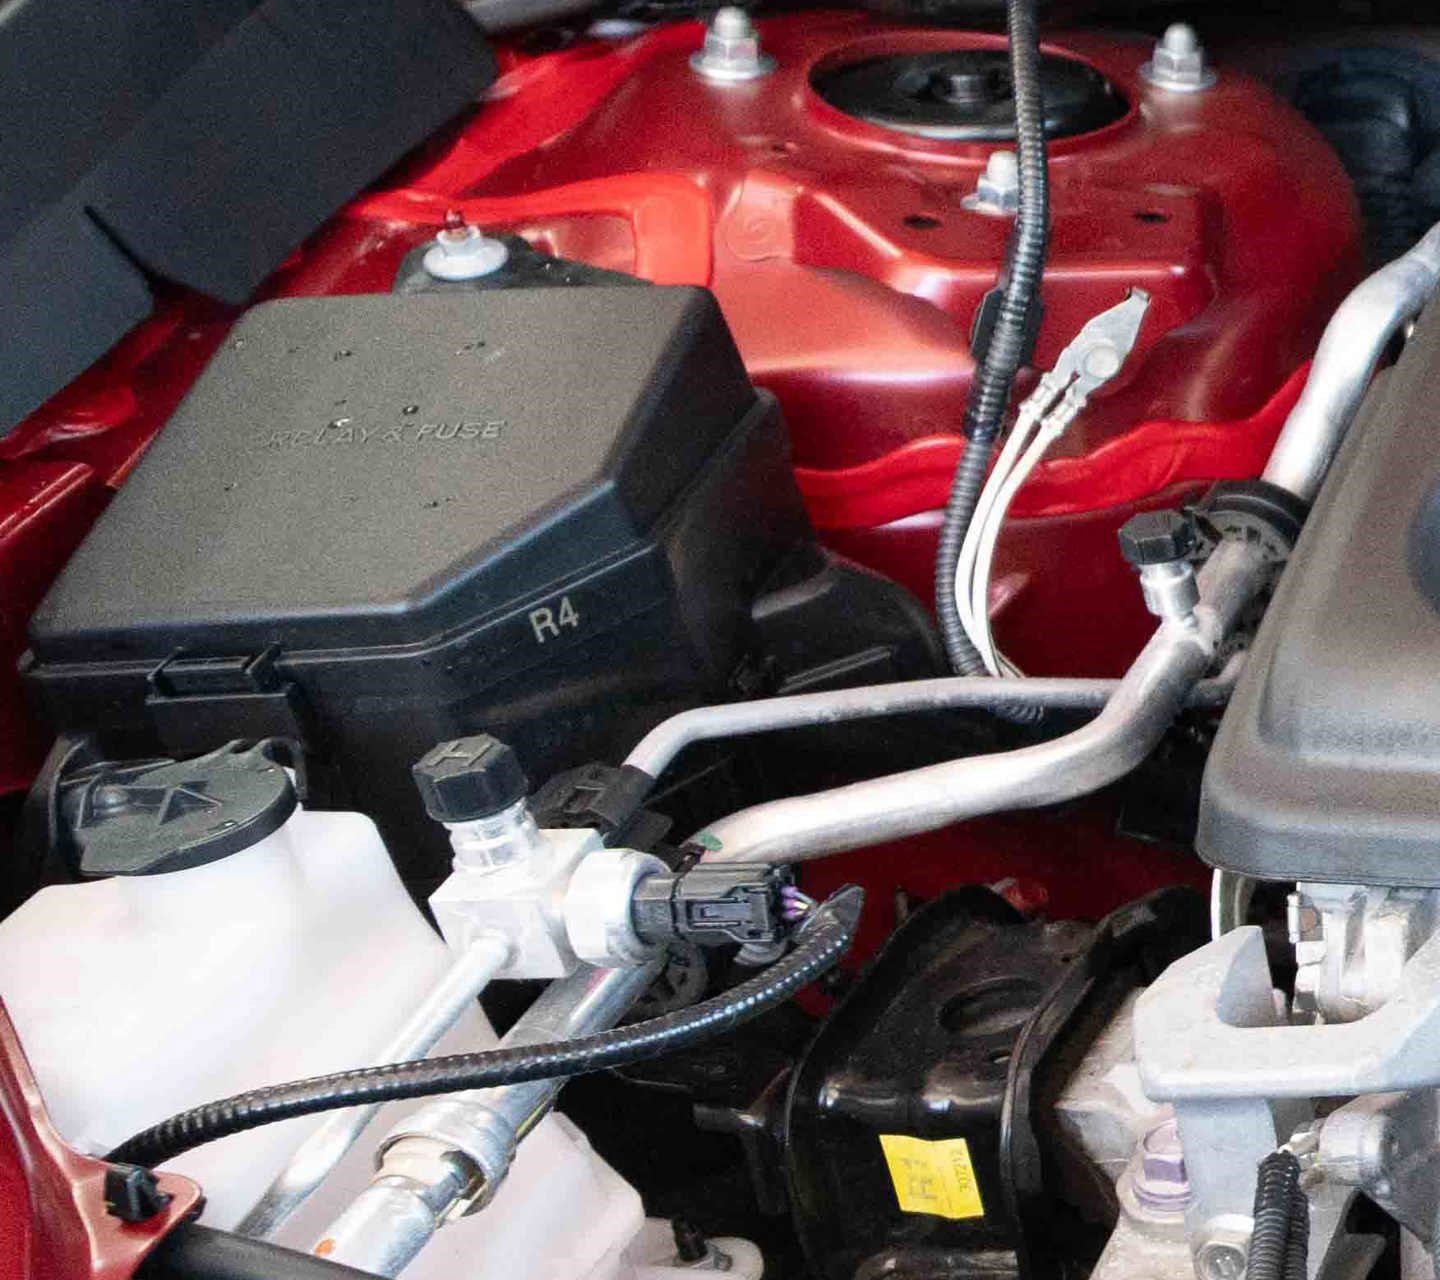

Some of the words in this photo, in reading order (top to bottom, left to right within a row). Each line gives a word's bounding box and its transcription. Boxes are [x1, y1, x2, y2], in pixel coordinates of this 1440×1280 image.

[262, 424, 379, 448] RELAY
[416, 420, 508, 441] FUSE
[528, 595, 580, 643] R4
